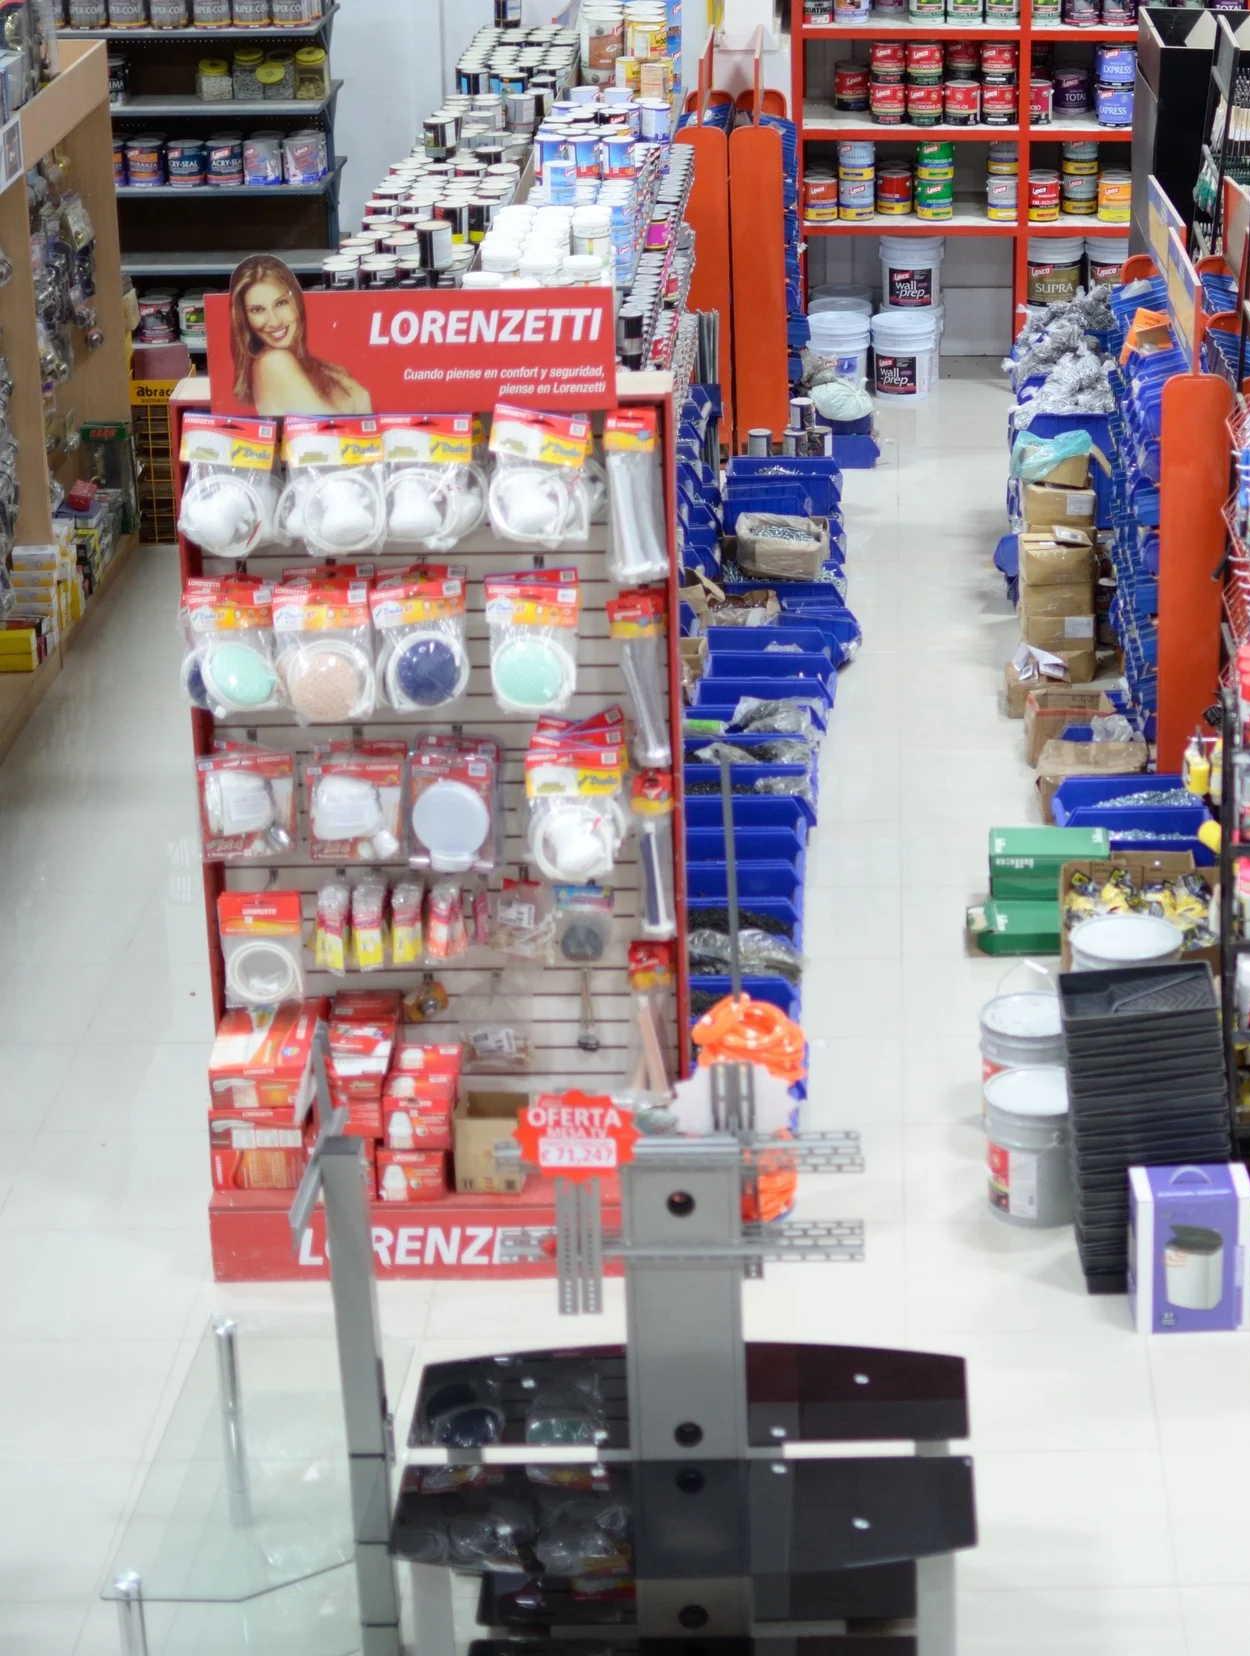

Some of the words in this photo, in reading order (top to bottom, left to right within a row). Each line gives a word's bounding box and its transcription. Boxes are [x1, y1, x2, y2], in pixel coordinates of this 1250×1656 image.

[1103, 66, 1132, 74] EXPRESS
[1065, 93, 1087, 101] TOTAL
[169, 159, 198, 168] CRY-SEAL
[211, 159, 242, 168] ACRY-SEA
[895, 280, 916, 290] wall
[1036, 283, 1073, 292] SUPRA
[895, 288, 925, 299] -prep
[369, 308, 602, 345] LORENZETTI
[404, 368, 443, 381] Cuando
[446, 367, 482, 382] piense
[484, 370, 497, 379] en
[500, 366, 539, 380] confort
[540, 370, 548, 381] y
[550, 365, 605, 382] seguridad,
[880, 367, 900, 377] wall
[880, 375, 908, 387] -prep
[499, 384, 534, 397] piense
[537, 385, 550, 394] en
[553, 381, 605, 394] Lorenzetti
[184, 417, 215, 425] LORENZETTI
[527, 1106, 622, 1128] OFERTA
[547, 1127, 588, 1138] MESA
[590, 1128, 608, 1138] TV
[299, 1226, 520, 1265] LRENZ
